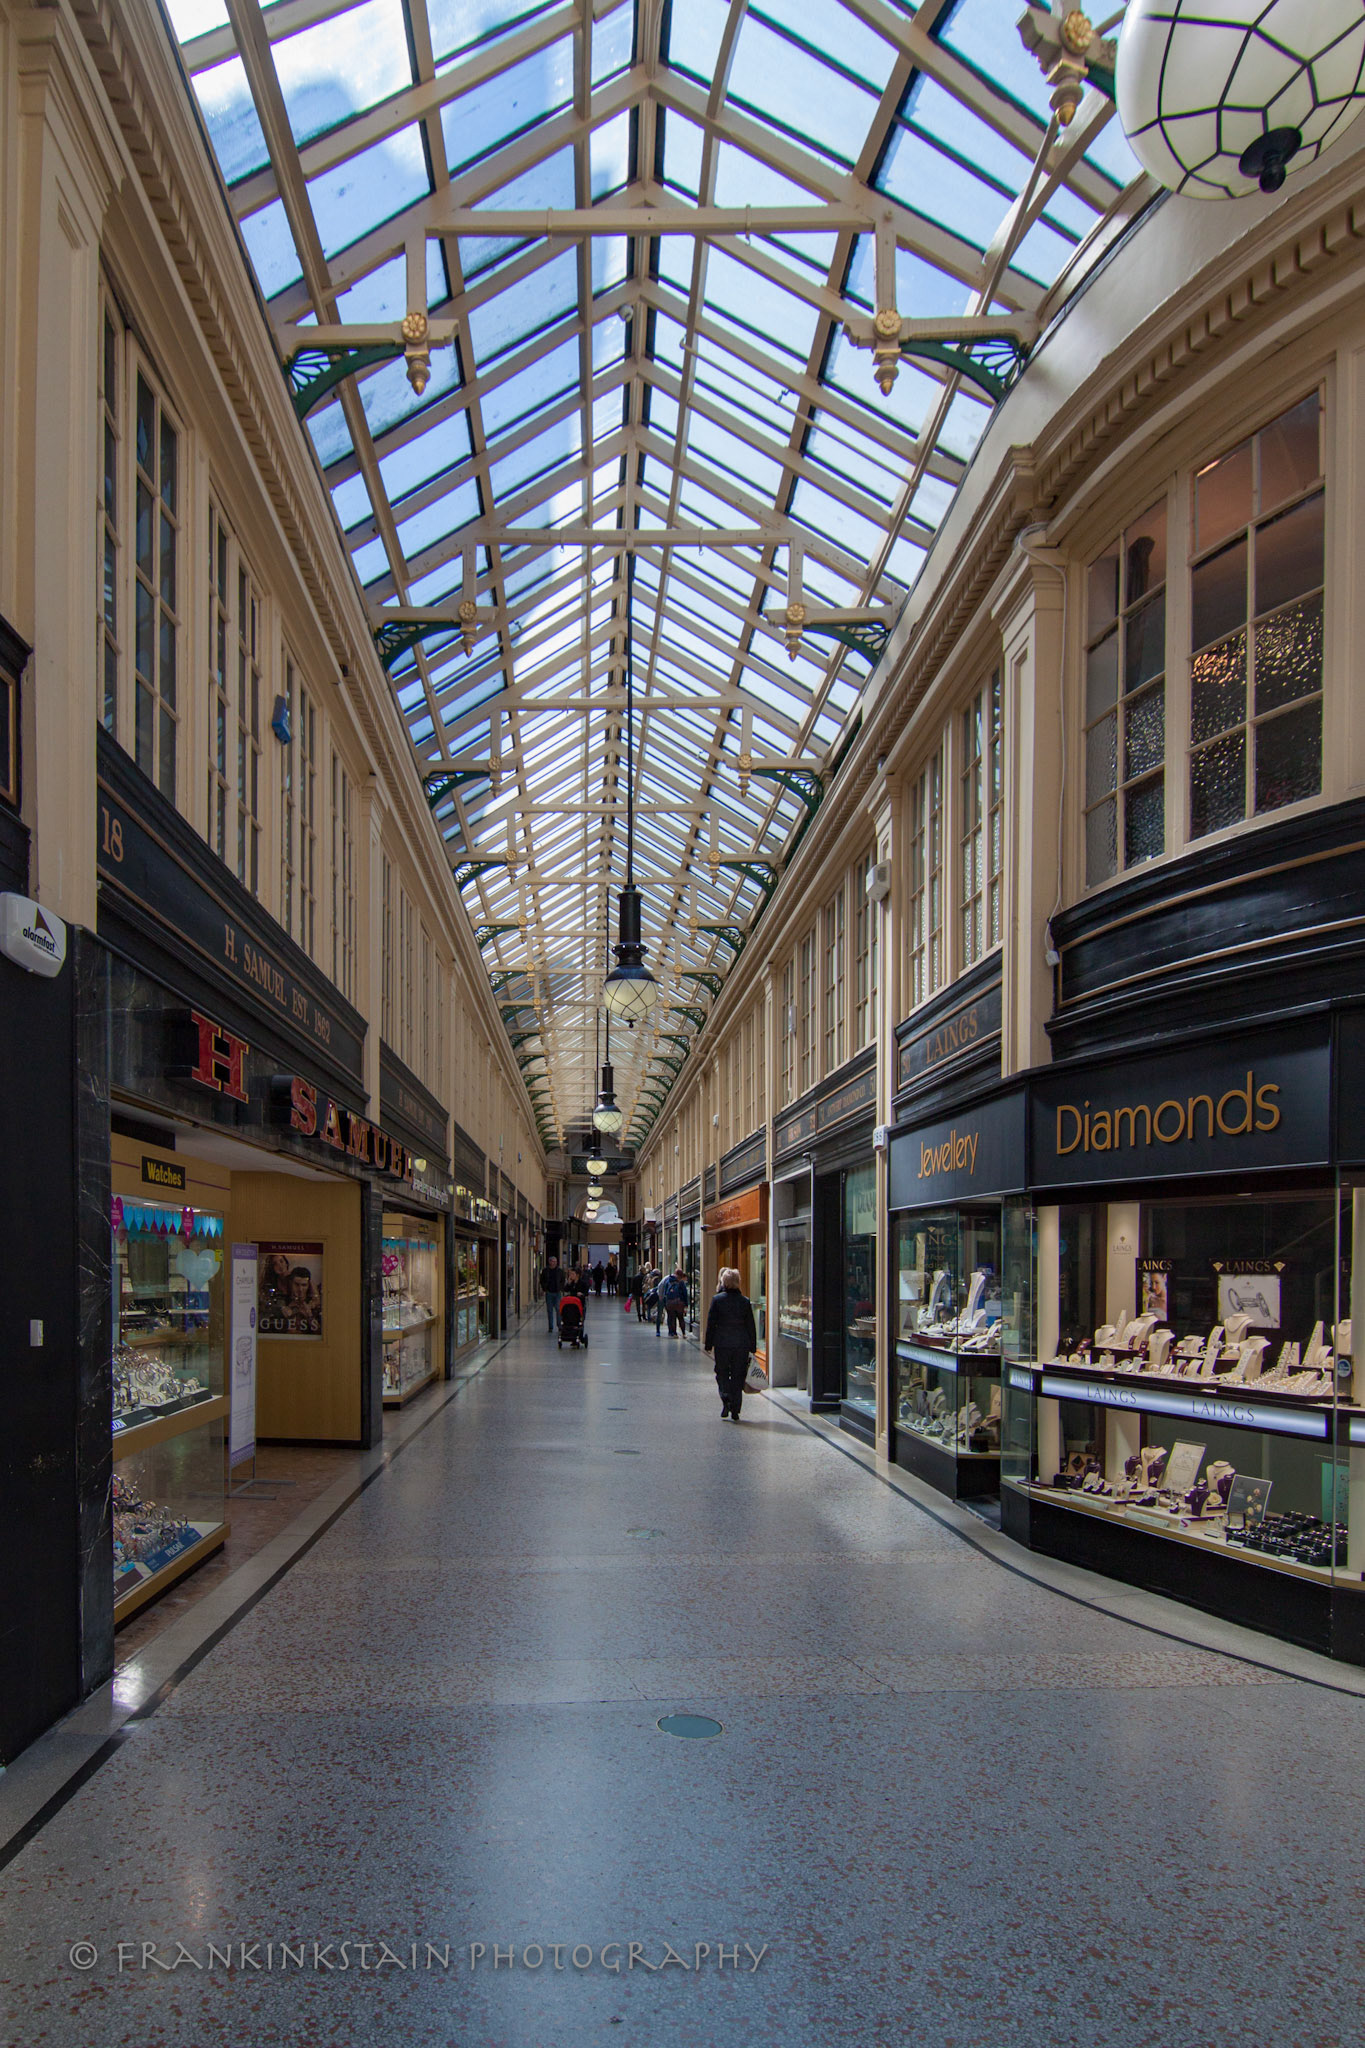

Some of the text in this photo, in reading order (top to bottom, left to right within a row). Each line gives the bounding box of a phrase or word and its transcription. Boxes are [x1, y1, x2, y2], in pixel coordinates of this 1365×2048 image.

[102, 806, 124, 863] 18
[23, 926, 55, 953] alarmfast
[224, 924, 238, 964] H.
[243, 943, 288, 1007] SAMUEL
[292, 987, 310, 1026] EST.
[926, 1008, 978, 1064] LAINGS
[191, 1007, 249, 1105] H
[290, 1074, 413, 1185] SAMUEL
[1056, 1070, 1281, 1155] Diamonds
[917, 1129, 979, 1179] Jewellery
[146, 1161, 182, 1186] Watches
[1226, 1260, 1271, 1273] LAINGS
[259, 1318, 320, 1332] GUESS
[1087, 1385, 1138, 1405] LAINGS
[1191, 1399, 1256, 1423] LAINGS
